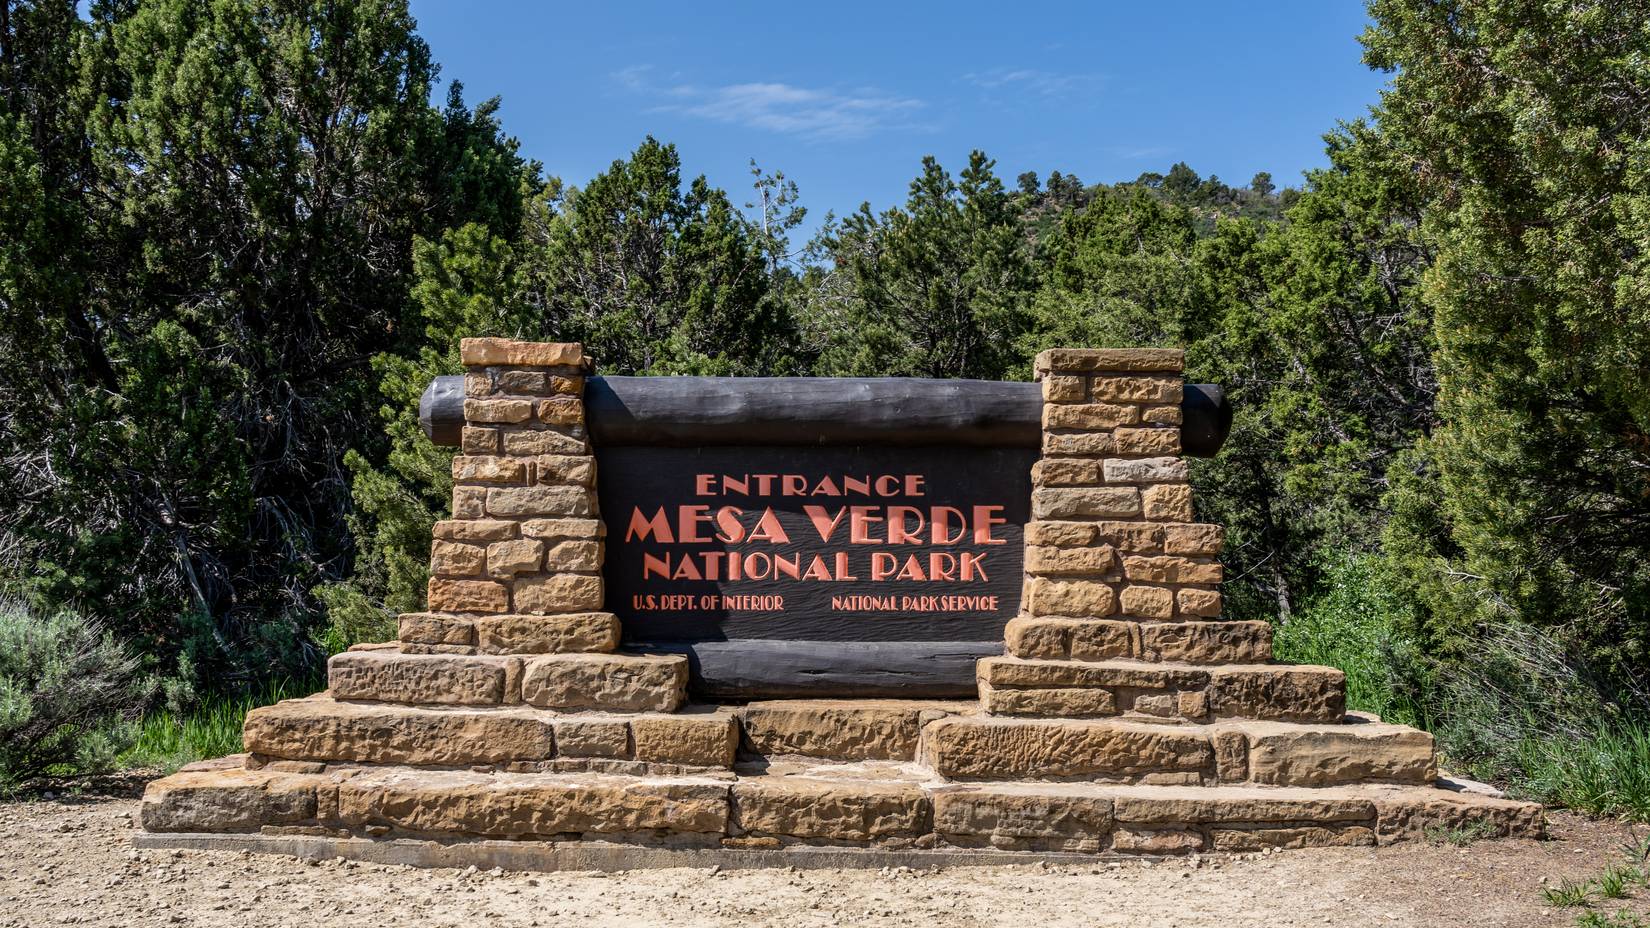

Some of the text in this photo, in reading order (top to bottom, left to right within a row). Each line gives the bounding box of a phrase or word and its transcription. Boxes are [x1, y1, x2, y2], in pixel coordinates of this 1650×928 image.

[696, 474, 925, 497] ENTRANCE
[625, 505, 1008, 546] MESA VERDE
[643, 551, 990, 583] NATIONAL PARK
[632, 594, 785, 611] U.S. DEPT. OF INTERIOR
[831, 595, 999, 612] NATIONAL PARK SERVICE
